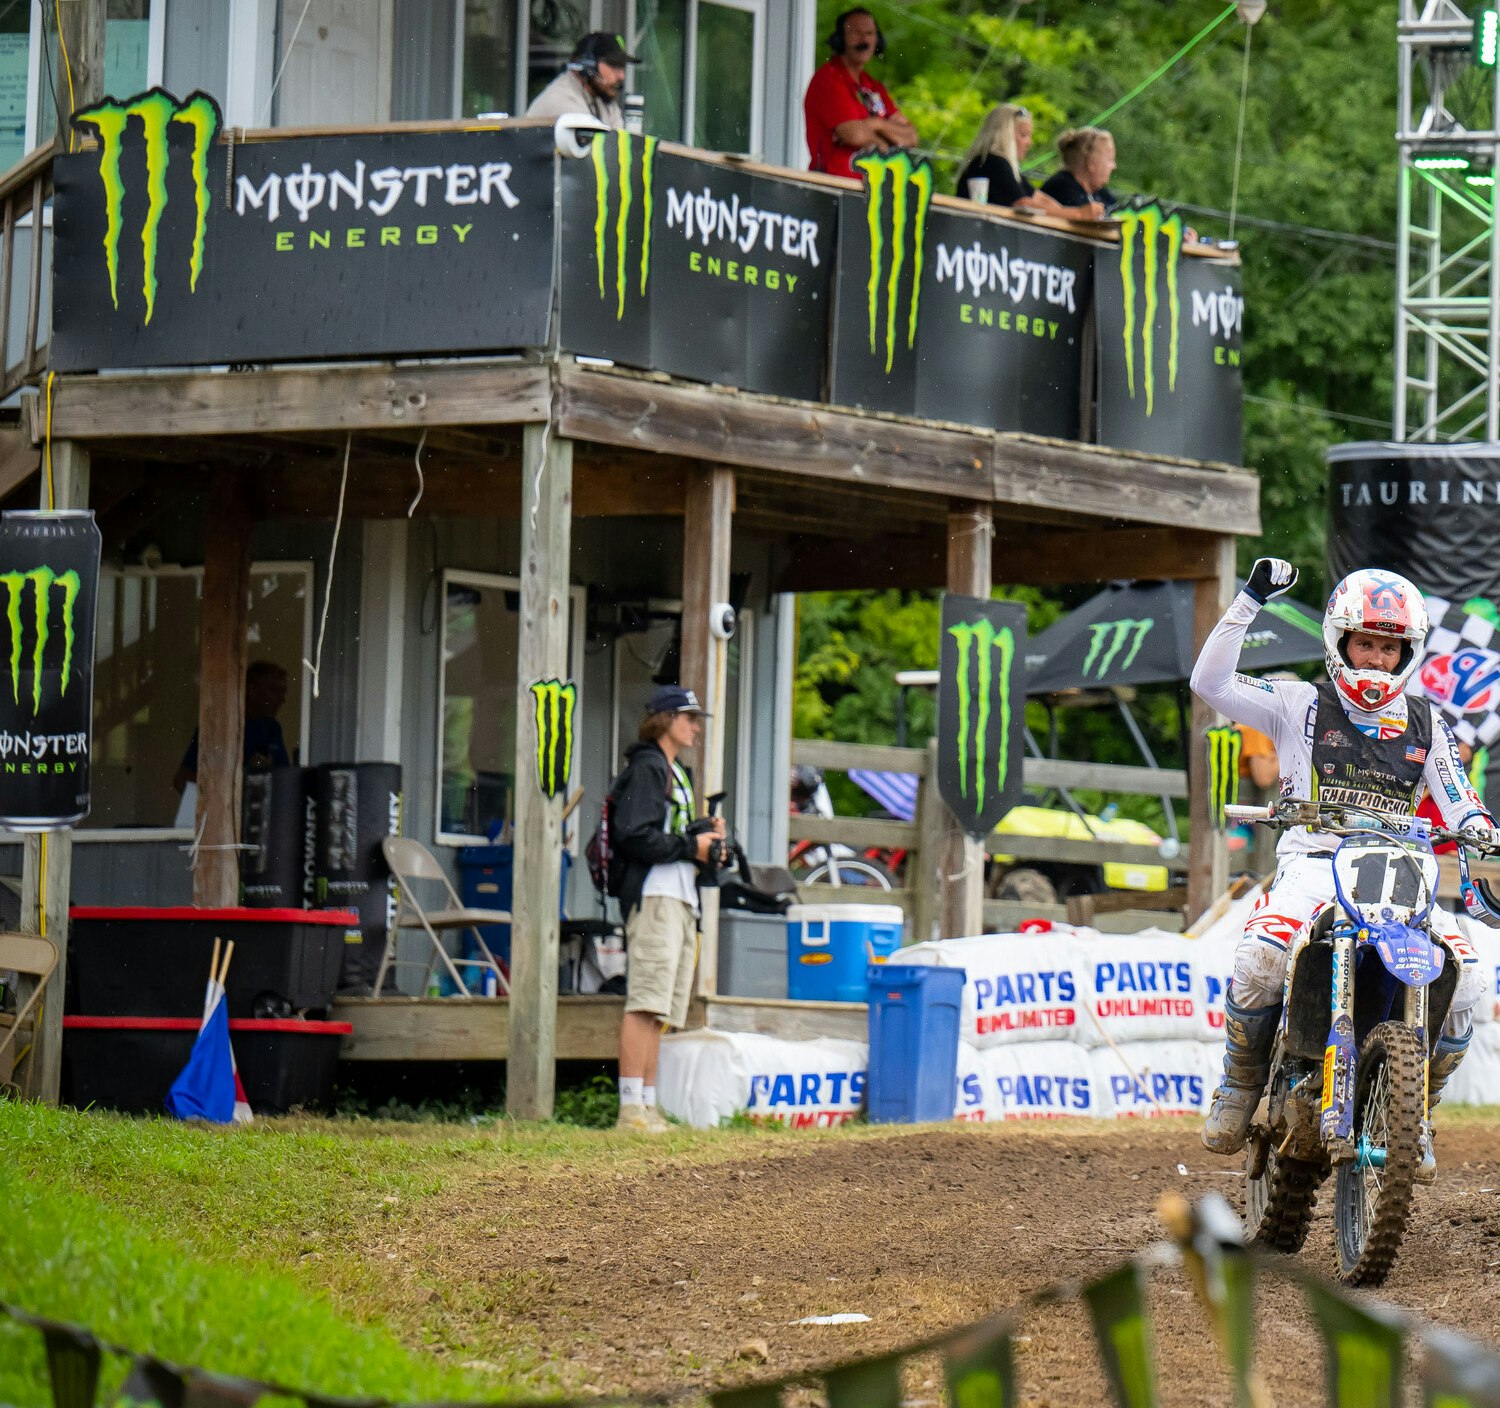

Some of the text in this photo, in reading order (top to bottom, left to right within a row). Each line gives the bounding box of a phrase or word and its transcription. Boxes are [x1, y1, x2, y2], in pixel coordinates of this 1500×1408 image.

[233, 159, 520, 222] MONSTER
[276, 224, 473, 251] ENERGY
[666, 186, 820, 268] MONSTER
[689, 251, 798, 293] ENERGY
[936, 240, 1076, 314] MONSTER
[960, 303, 1060, 340] ENERGY
[1350, 852, 1424, 909] 11
[974, 971, 1076, 1010] PARTS
[1095, 962, 1192, 993] PARTS
[977, 1008, 1076, 1034] UNLIMITED
[1097, 999, 1194, 1017] UNLIMITED
[997, 1075, 1091, 1109] PARTS
[1110, 1073, 1204, 1106] PARTS
